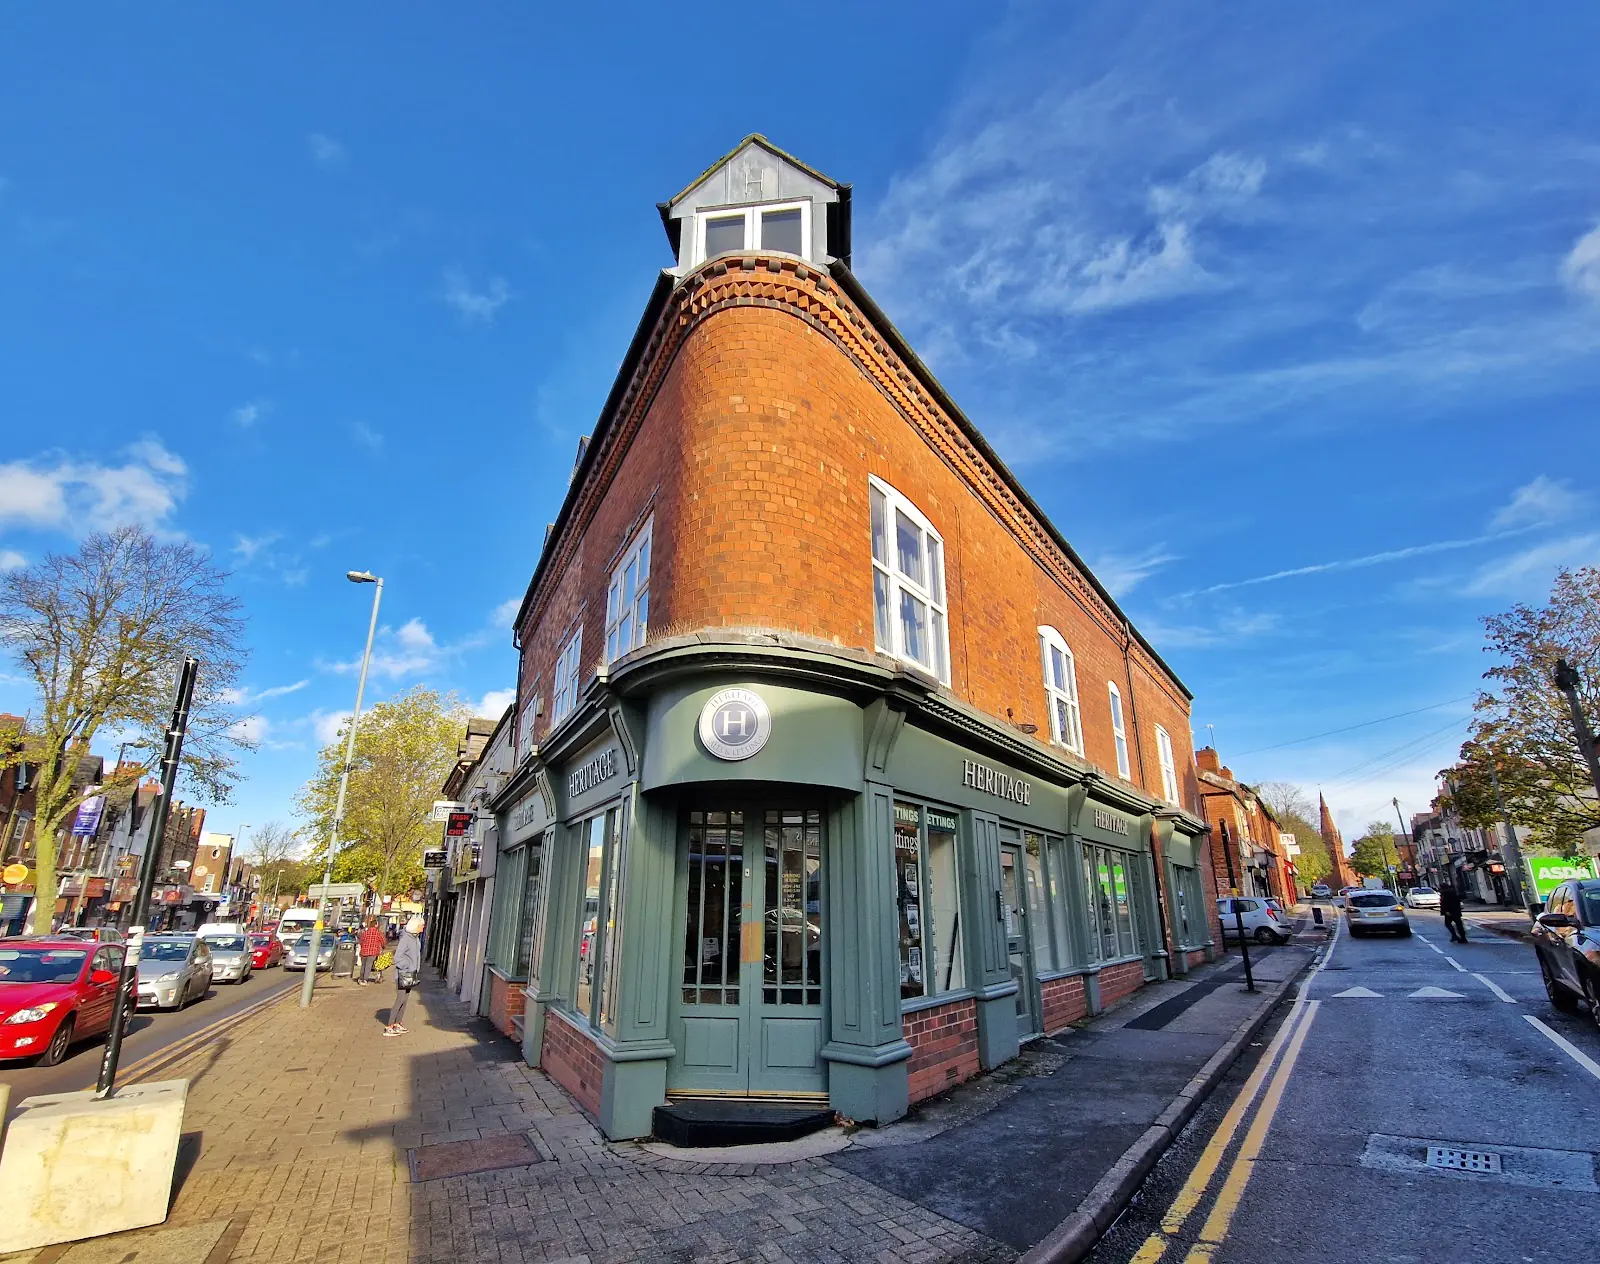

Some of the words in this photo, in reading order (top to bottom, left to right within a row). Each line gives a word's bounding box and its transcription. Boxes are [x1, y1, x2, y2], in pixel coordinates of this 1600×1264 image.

[721, 710, 749, 737] H
[732, 734, 764, 757] LETTINGS
[568, 748, 615, 799] HERITAGE
[963, 759, 1031, 806] HERITAGE
[447, 828, 465, 836] CHIP
[1094, 809, 1129, 836] HERITAGE
[1538, 866, 1592, 880] ASDA
